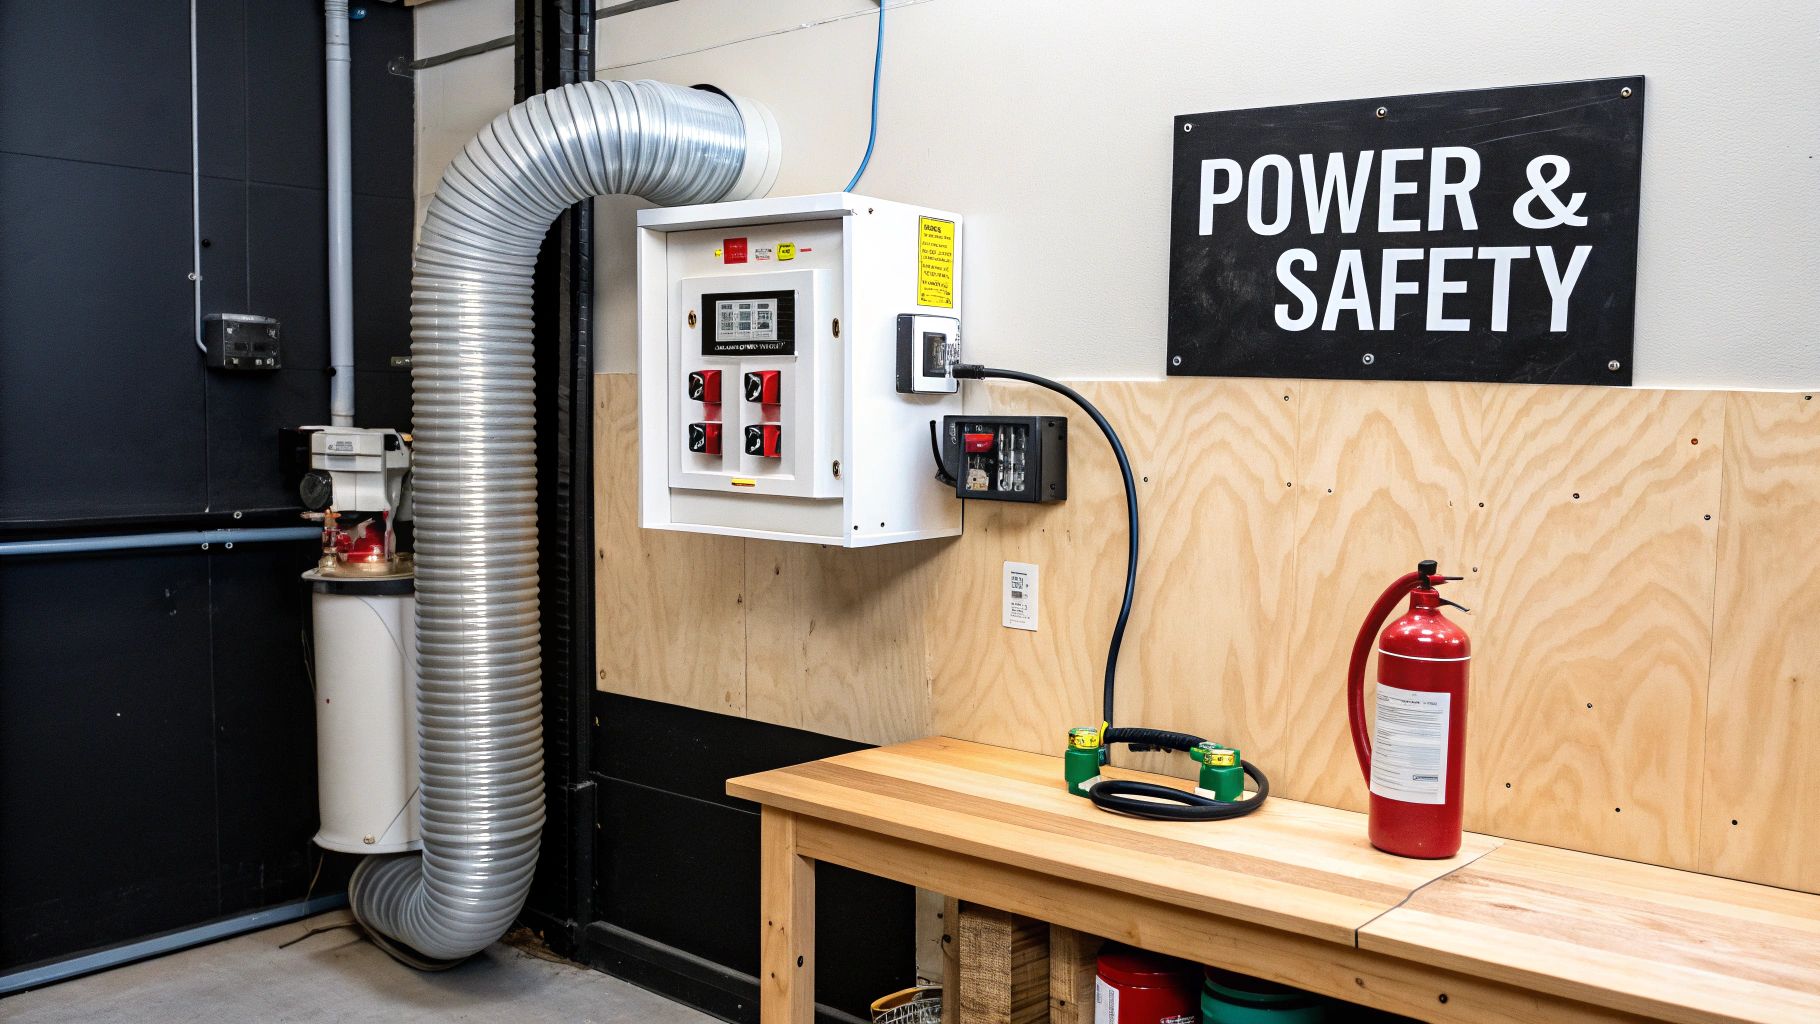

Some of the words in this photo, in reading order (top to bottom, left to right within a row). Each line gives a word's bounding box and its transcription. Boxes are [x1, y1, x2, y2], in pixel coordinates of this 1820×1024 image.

[1199, 146, 1481, 236] POWER
[1512, 154, 1589, 230] &
[1274, 245, 1593, 332] SAFETY
